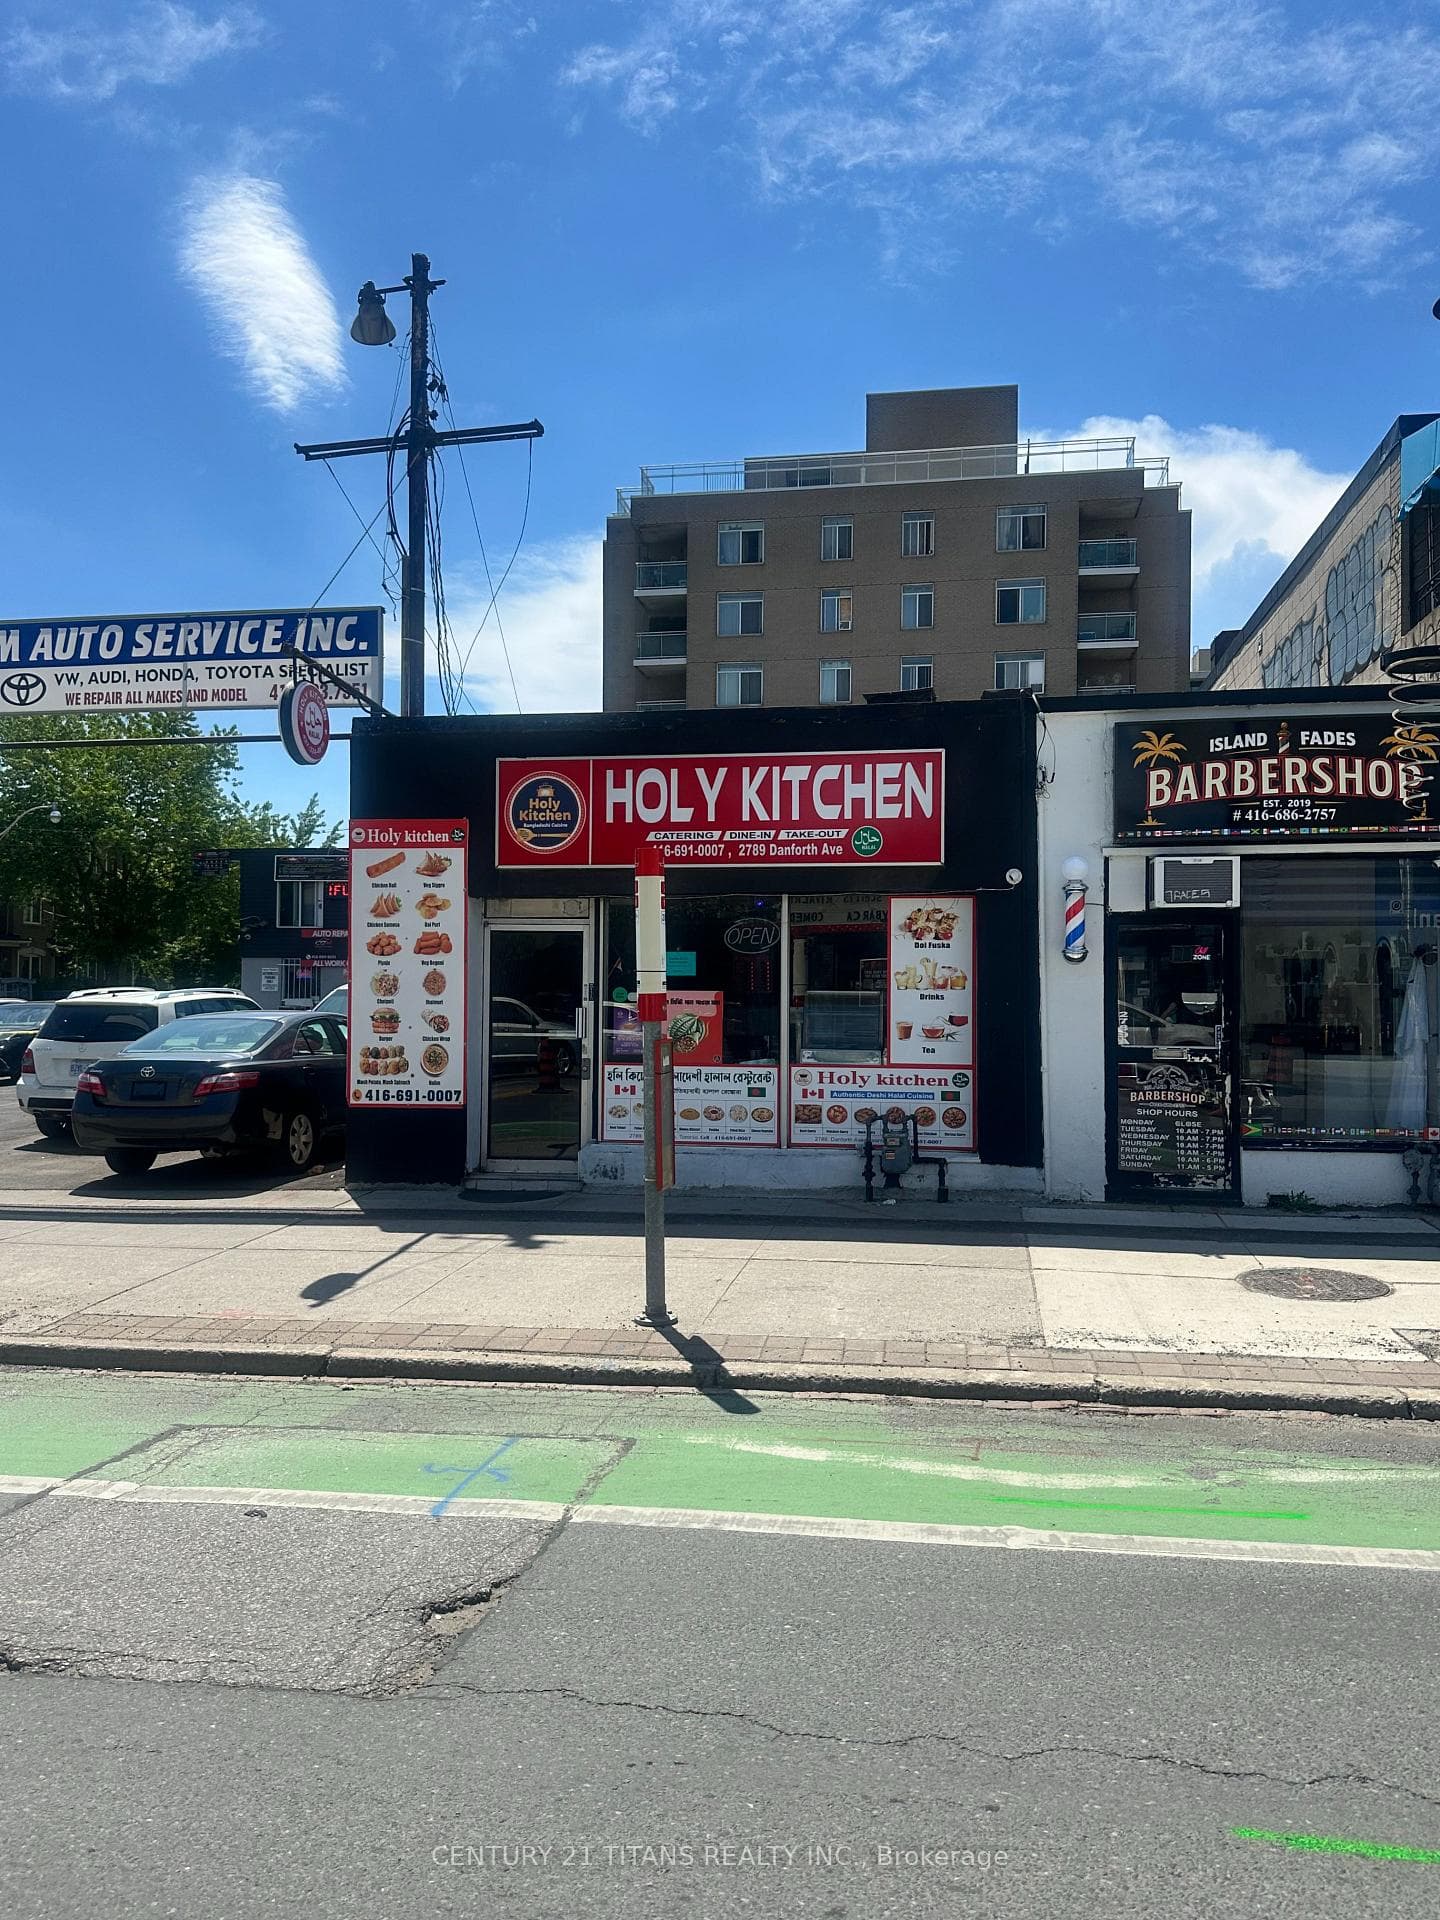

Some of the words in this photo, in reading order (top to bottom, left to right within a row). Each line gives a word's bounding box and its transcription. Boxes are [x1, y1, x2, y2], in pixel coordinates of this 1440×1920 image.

[29, 623, 125, 662] AUTO
[131, 618, 285, 658] SERVICE
[294, 616, 369, 653] INC.
[54, 671, 84, 688] VW,
[88, 669, 130, 686] AUDI,
[135, 668, 199, 684] HONDA,
[205, 665, 274, 680] TOYOTA
[65, 692, 81, 706] WE
[83, 691, 122, 706] REPAIR
[125, 690, 144, 704] ALL
[146, 689, 182, 704] MAKES
[186, 688, 208, 703] AND
[211, 687, 248, 702] MODEL
[1209, 732, 1268, 752] ISLAND
[1300, 731, 1356, 746] FADES
[1147, 755, 1422, 808] BARBERSHOP
[606, 767, 728, 823] HOLY
[741, 761, 934, 821] KITCHEN
[529, 798, 561, 812] Holy
[1263, 800, 1283, 808] EST.
[1287, 799, 1311, 808] 2019
[520, 810, 571, 821] Kitchen
[1245, 808, 1336, 821] 416-686-2757
[368, 828, 402, 845] Holy
[405, 830, 449, 843] kitchen
[654, 832, 714, 840] CATERING
[729, 831, 772, 839] DINE-IN
[785, 829, 843, 839] TAKE-OUT
[739, 844, 766, 857] 2789
[769, 843, 818, 856] Danforth
[821, 843, 843, 855] Ave
[727, 926, 775, 945] OPEN
[818, 1071, 871, 1088] Holy
[876, 1073, 949, 1087] kitchen
[365, 1090, 462, 1101] 416-691-0007
[1130, 1091, 1206, 1104] BARBERSHOP
[1165, 1110, 1198, 1118] HOURS
